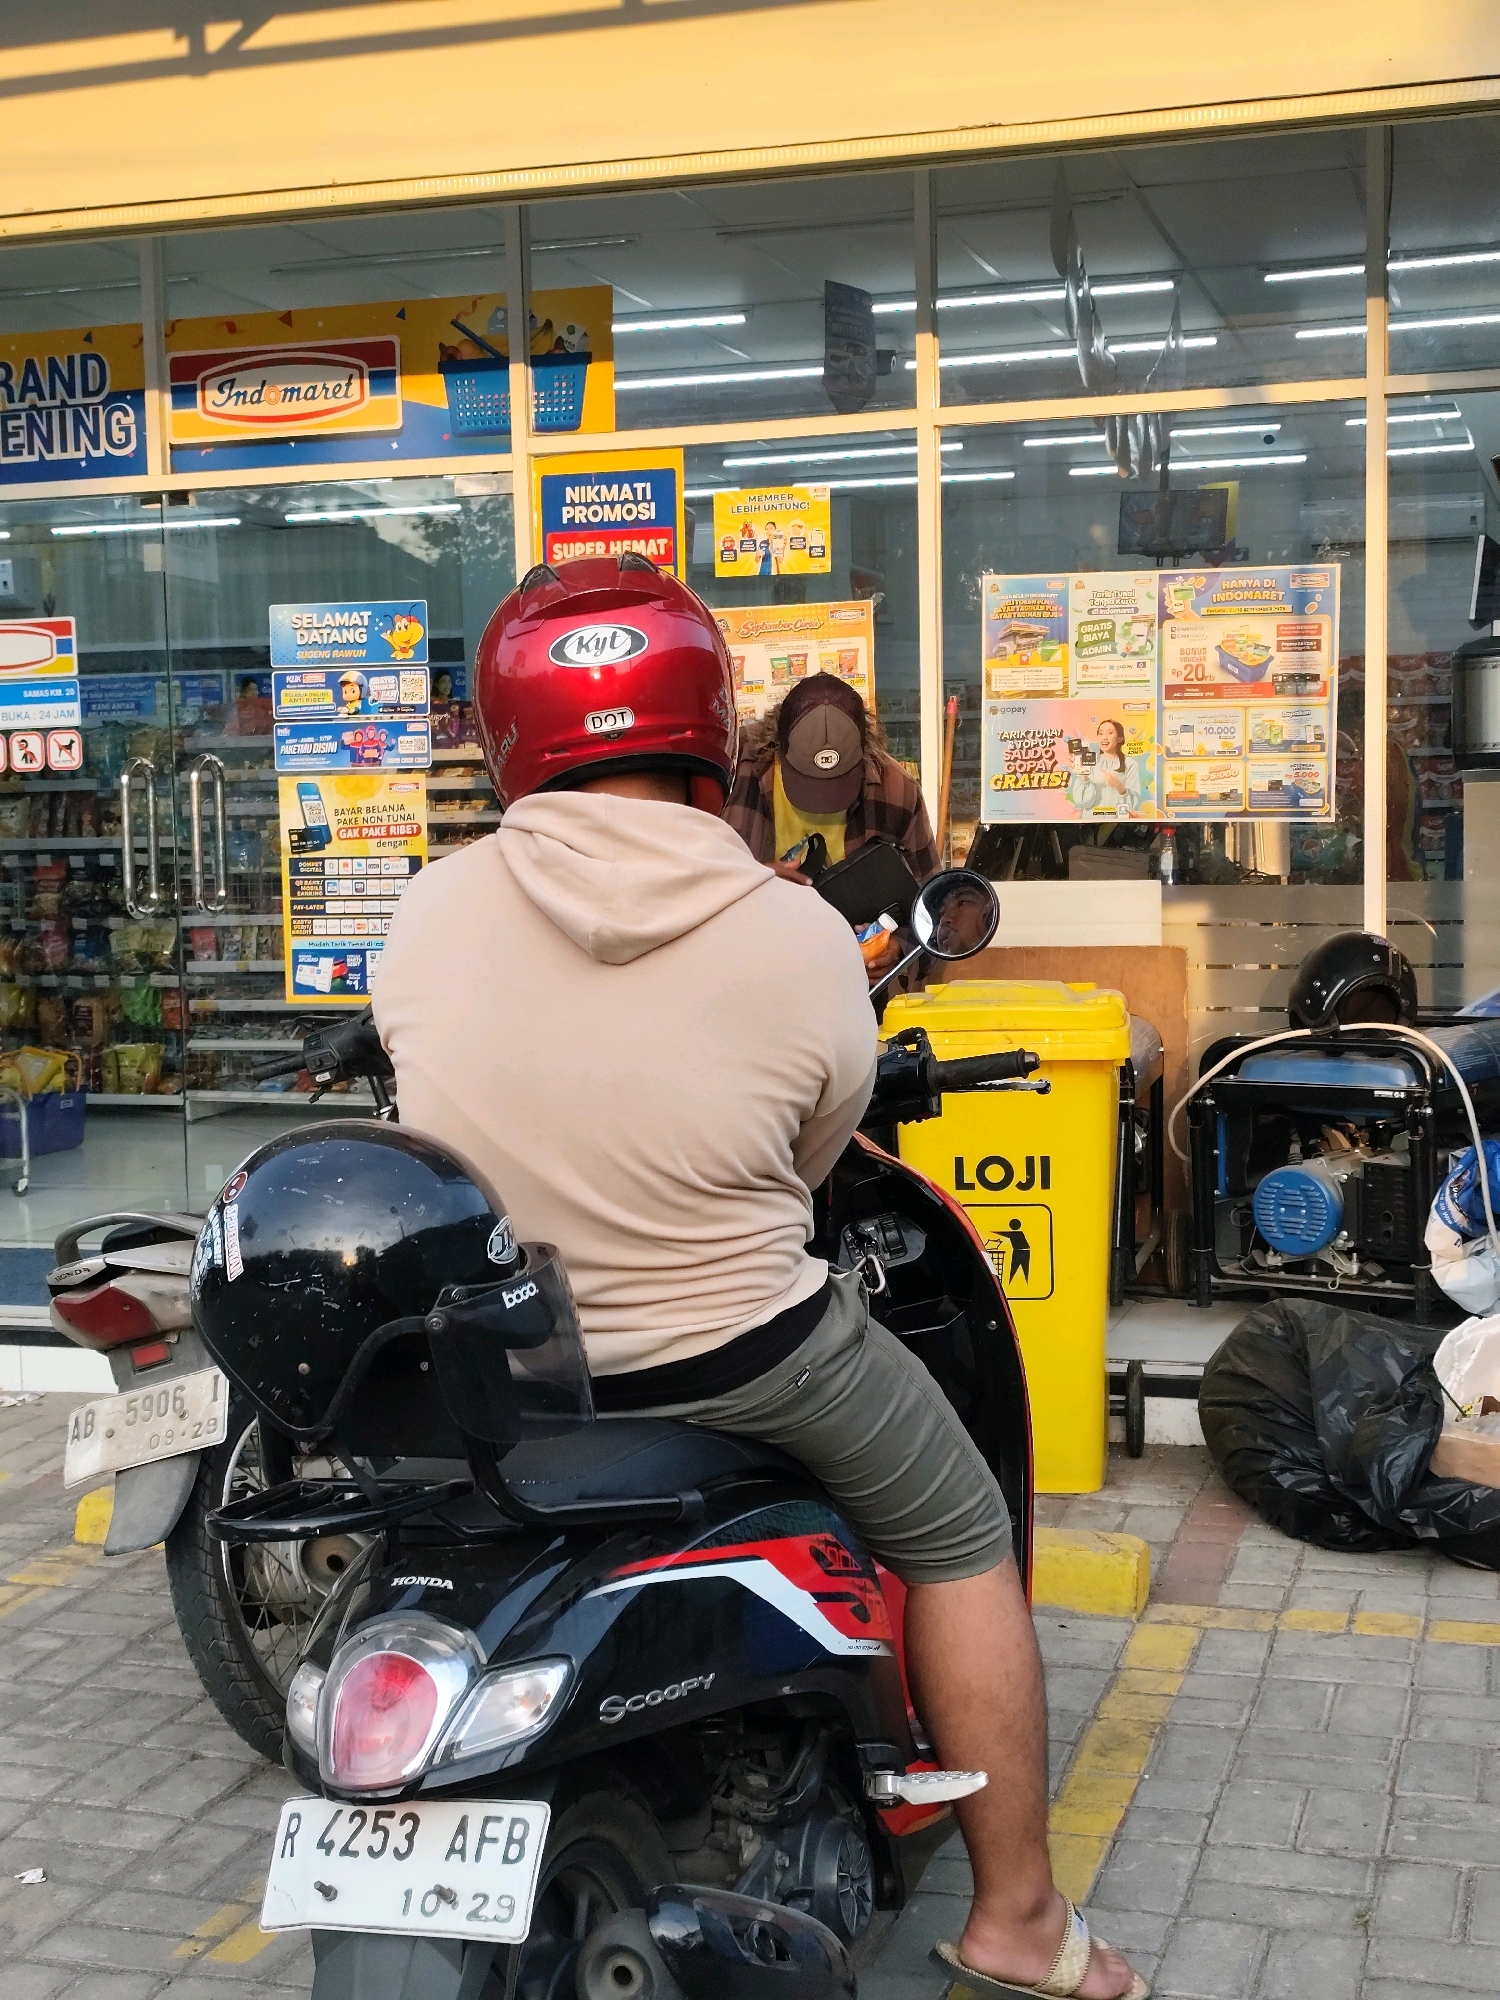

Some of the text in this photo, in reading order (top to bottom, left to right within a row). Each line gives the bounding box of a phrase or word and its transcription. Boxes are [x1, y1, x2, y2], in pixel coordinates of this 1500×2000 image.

[212, 374, 354, 408] Indomaret
[565, 482, 652, 504] NIKMATI
[748, 493, 794, 503] MEMBER
[562, 502, 656, 524] PROMOSI
[731, 502, 810, 514] LEBIH UNTUNG!
[552, 538, 668, 561] SUPER HEMAT
[1222, 578, 1276, 590] HANYA DI
[1092, 589, 1136, 600] Tarik Tunai
[1212, 591, 1285, 603] INDOMARET
[1090, 597, 1137, 607] Tanpa Kartu
[291, 611, 372, 629] SELAMAT
[738, 619, 793, 638] September
[1080, 621, 1113, 634] GRATIS
[296, 628, 368, 645] DATANG
[1083, 632, 1110, 643] BIAYA
[296, 649, 366, 659] SUGENG RAWUH
[1082, 644, 1112, 656] ADMIN
[1179, 648, 1207, 656] BONUS
[1171, 669, 1182, 678] Rp
[23, 689, 49, 698] SAMAS
[50, 688, 65, 697] KM.
[66, 688, 75, 696] 20
[2, 711, 30, 721] BUKA
[39, 710, 51, 720] 24
[53, 709, 75, 719] JAM
[1001, 706, 1027, 714] gopay
[591, 711, 628, 730] DOT
[998, 729, 1062, 740] TARIK TUNAI
[1203, 726, 1236, 735] 10.000
[280, 742, 338, 755] PAKETMU DISINI
[1017, 740, 1039, 749] TOP
[1040, 738, 1054, 747] UP
[1003, 748, 1054, 761] SALDO
[1003, 760, 1056, 773] GOPAY
[989, 773, 1070, 790] GRATIS!
[334, 803, 405, 816] BAYAR BELANJA
[337, 813, 415, 826] PAKE NON TUNAI
[339, 824, 418, 838] GAK PAKE RIBET
[376, 839, 408, 849] dengan
[954, 1155, 1050, 1192] LOJI
[54, 1267, 91, 1282] HONDA
[70, 1408, 96, 1446] AB
[125, 1384, 187, 1427] 5906
[391, 1576, 453, 1590] HONDA
[281, 1809, 531, 1865] R 4253 AFB
